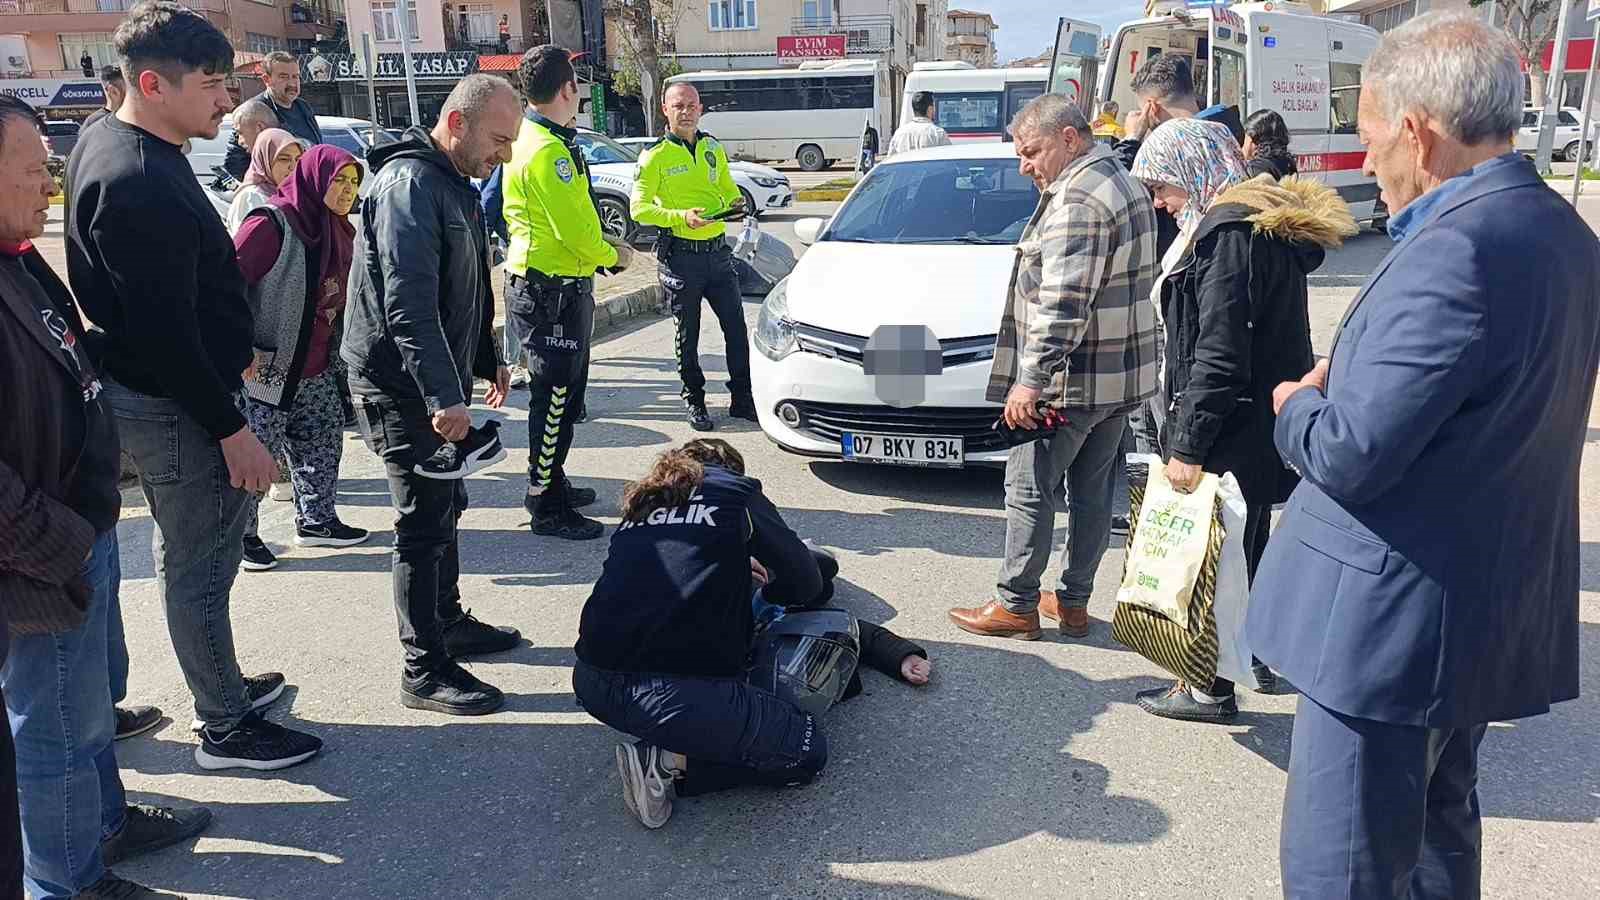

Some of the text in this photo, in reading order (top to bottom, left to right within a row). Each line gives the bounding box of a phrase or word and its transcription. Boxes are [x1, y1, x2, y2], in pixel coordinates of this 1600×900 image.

[338, 56, 400, 76] SAİL
[1296, 155, 1321, 171] LANS
[853, 435, 959, 460] 07 BKY 834
